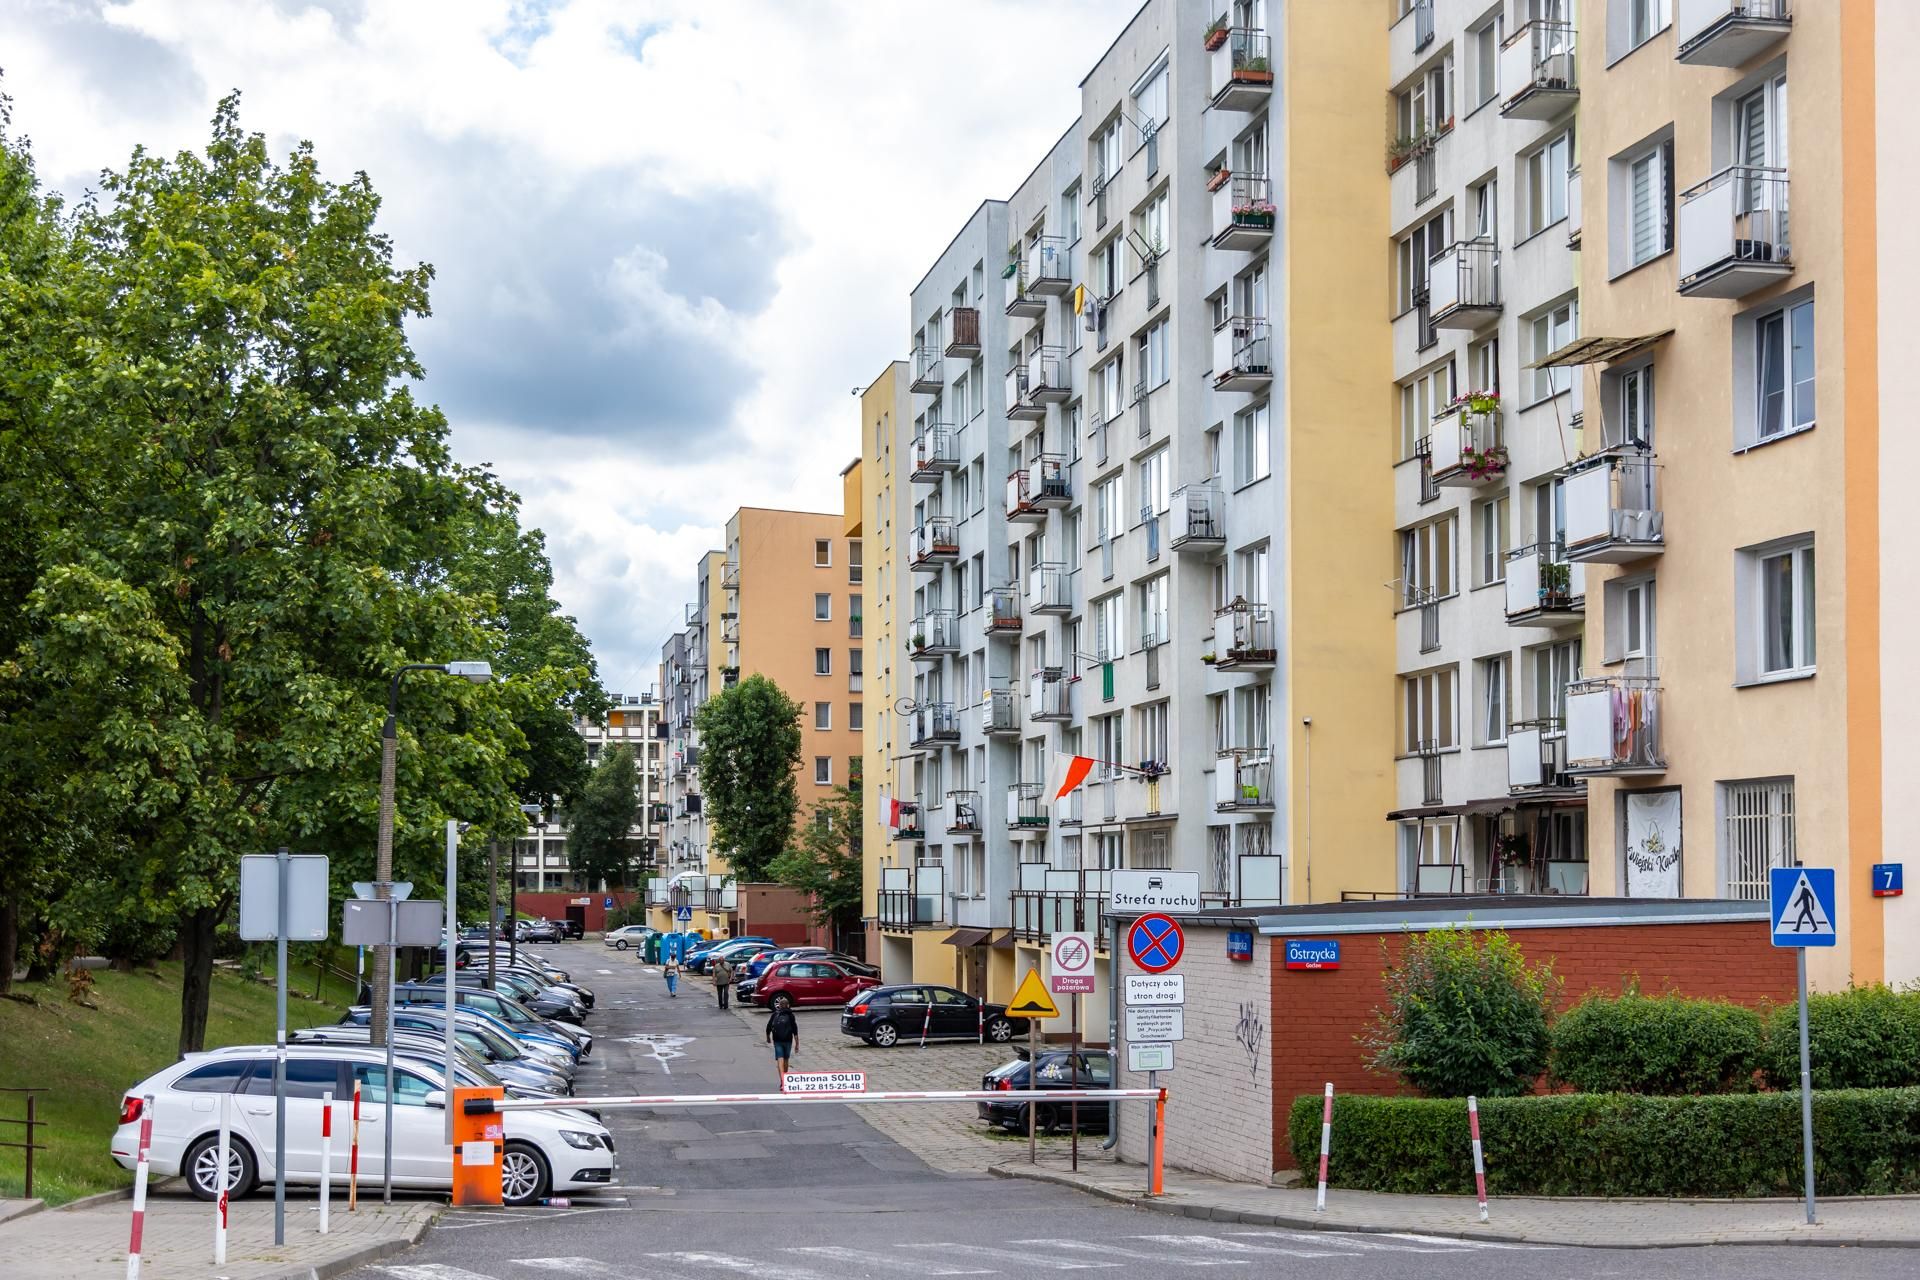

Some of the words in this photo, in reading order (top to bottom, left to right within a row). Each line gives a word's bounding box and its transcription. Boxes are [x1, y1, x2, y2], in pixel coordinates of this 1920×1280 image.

[1884, 871, 1893, 889] 7
[1115, 893, 1155, 905] Strefa
[1160, 894, 1197, 906] ruchu
[1290, 947, 1336, 962] Ostrzycka
[1062, 977, 1083, 985] Droga
[1131, 980, 1160, 988] Dotyczy
[1163, 979, 1178, 987] obu
[1155, 992, 1176, 1001] drogi
[786, 1075, 828, 1083] Ochrona
[831, 1074, 861, 1082] SOLID
[805, 1083, 816, 1091] 22
